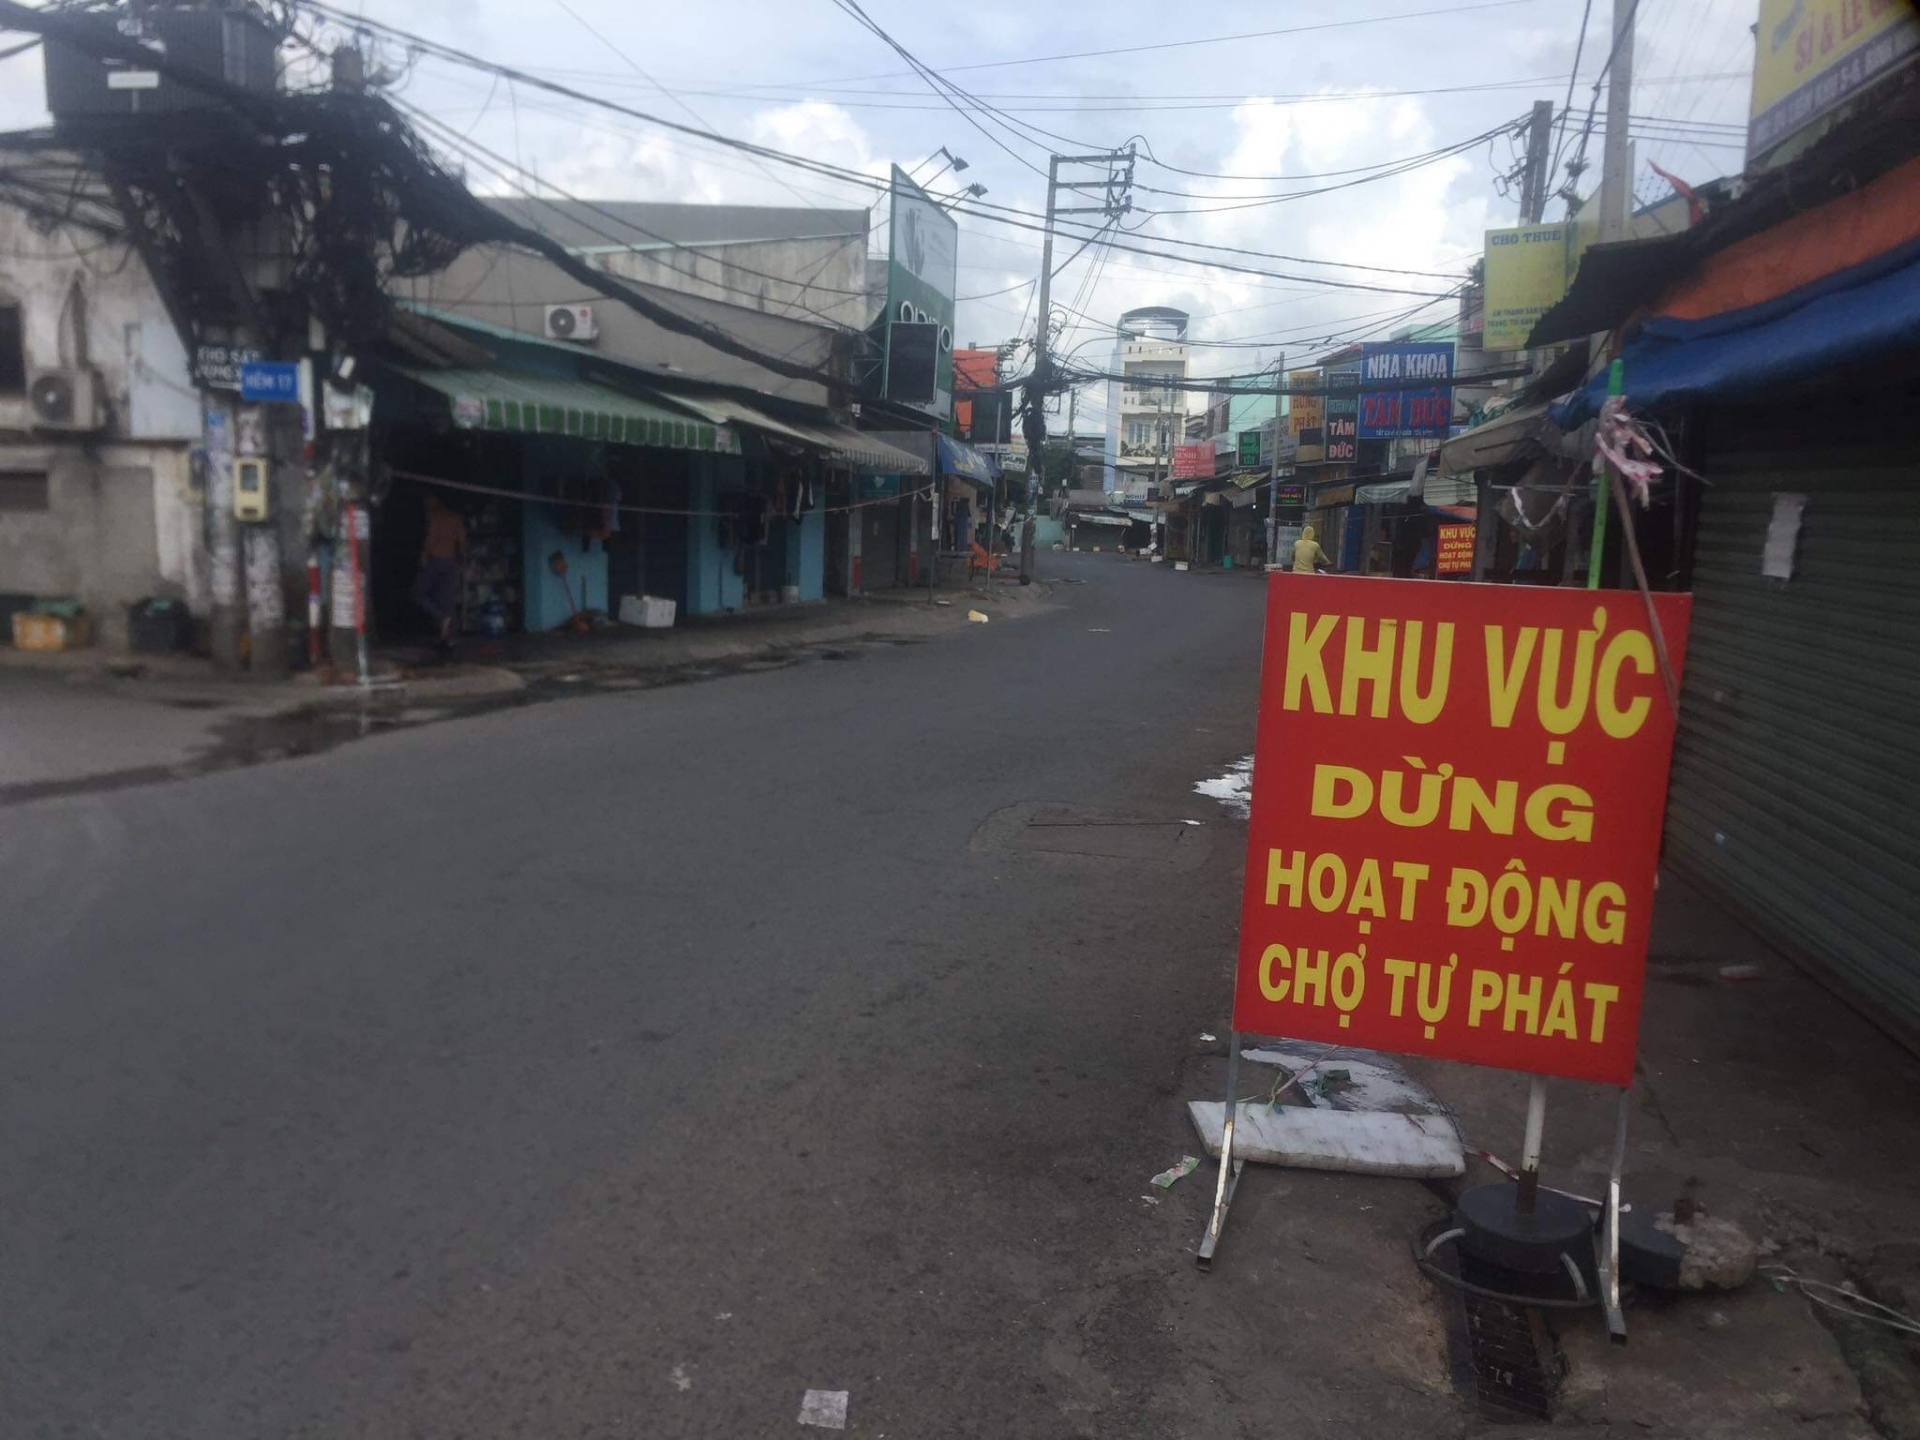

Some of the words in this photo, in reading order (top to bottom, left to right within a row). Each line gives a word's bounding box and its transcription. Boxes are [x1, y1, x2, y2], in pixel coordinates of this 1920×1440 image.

[1491, 233, 1519, 247] CHO
[1367, 353, 1400, 379] NHA
[1405, 353, 1448, 379] KHOA
[1329, 418, 1355, 436] TÂM
[1329, 440, 1353, 458] ĐỨC
[1440, 527, 1458, 539] KHU
[1283, 611, 1455, 725] KHU
[1484, 606, 1656, 765] VỰC
[1311, 755, 1595, 843] DỪNG
[1264, 847, 1430, 935] HOẠT
[1445, 857, 1628, 952] ĐỘNG
[1258, 943, 1367, 1029] CHỢ
[1383, 952, 1459, 1041] TỰ
[1467, 962, 1620, 1044] PHÁT
